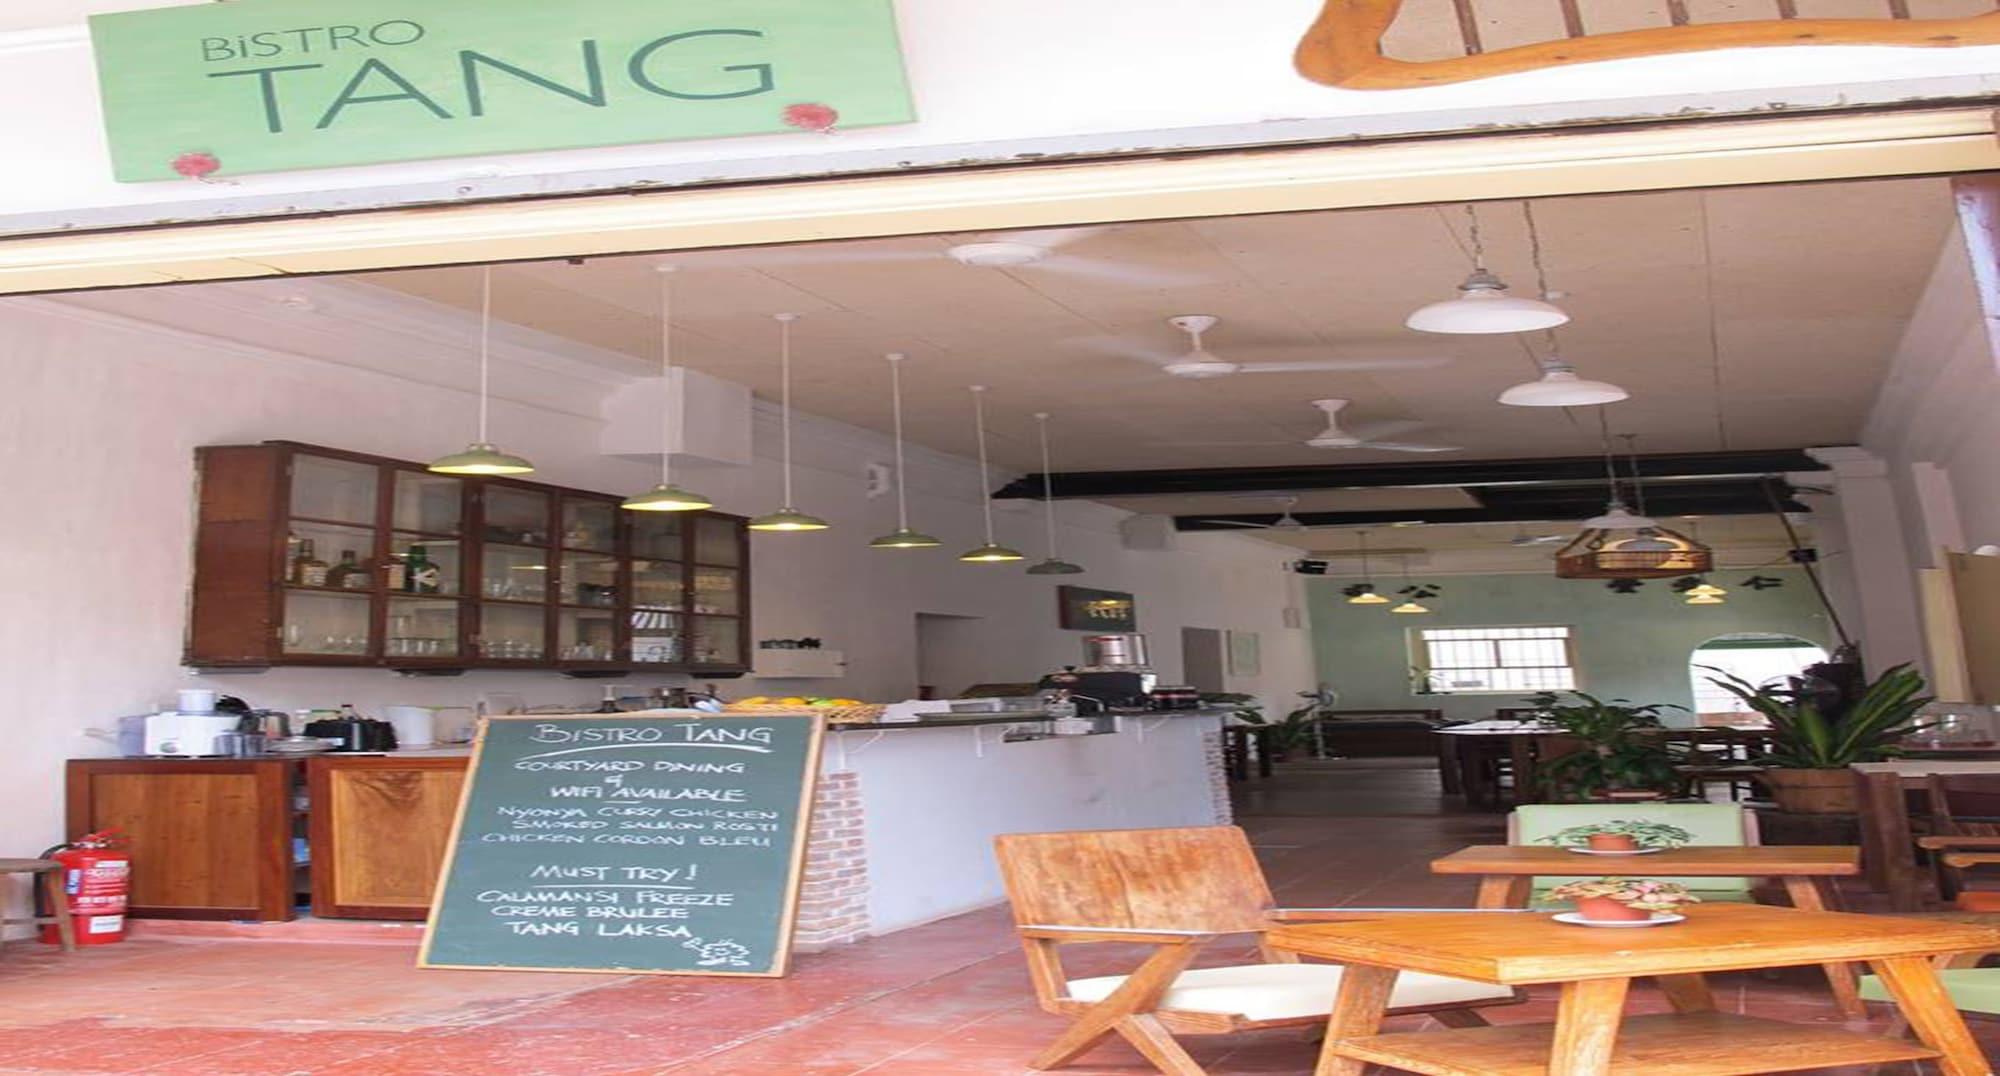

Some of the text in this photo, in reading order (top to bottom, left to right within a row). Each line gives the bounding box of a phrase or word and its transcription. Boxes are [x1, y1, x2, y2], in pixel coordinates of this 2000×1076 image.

[206, 29, 775, 133] TANG
[528, 723, 774, 743] BISTRO TANG
[514, 760, 745, 774] COURTYARD DINING
[549, 786, 746, 801] WIFI AVAILABLE
[497, 804, 778, 820] NYONYA CURRY CHICKEN
[512, 820, 778, 832] SMOKED SALMON ROSTI
[482, 833, 770, 847] CHICKEN CORDON BLEU
[620, 866, 680, 883] TRY
[477, 890, 734, 906] CALAMANSI FREEZE
[490, 906, 690, 919] CREME BRULEE
[504, 921, 693, 939] TANG LAKSA
